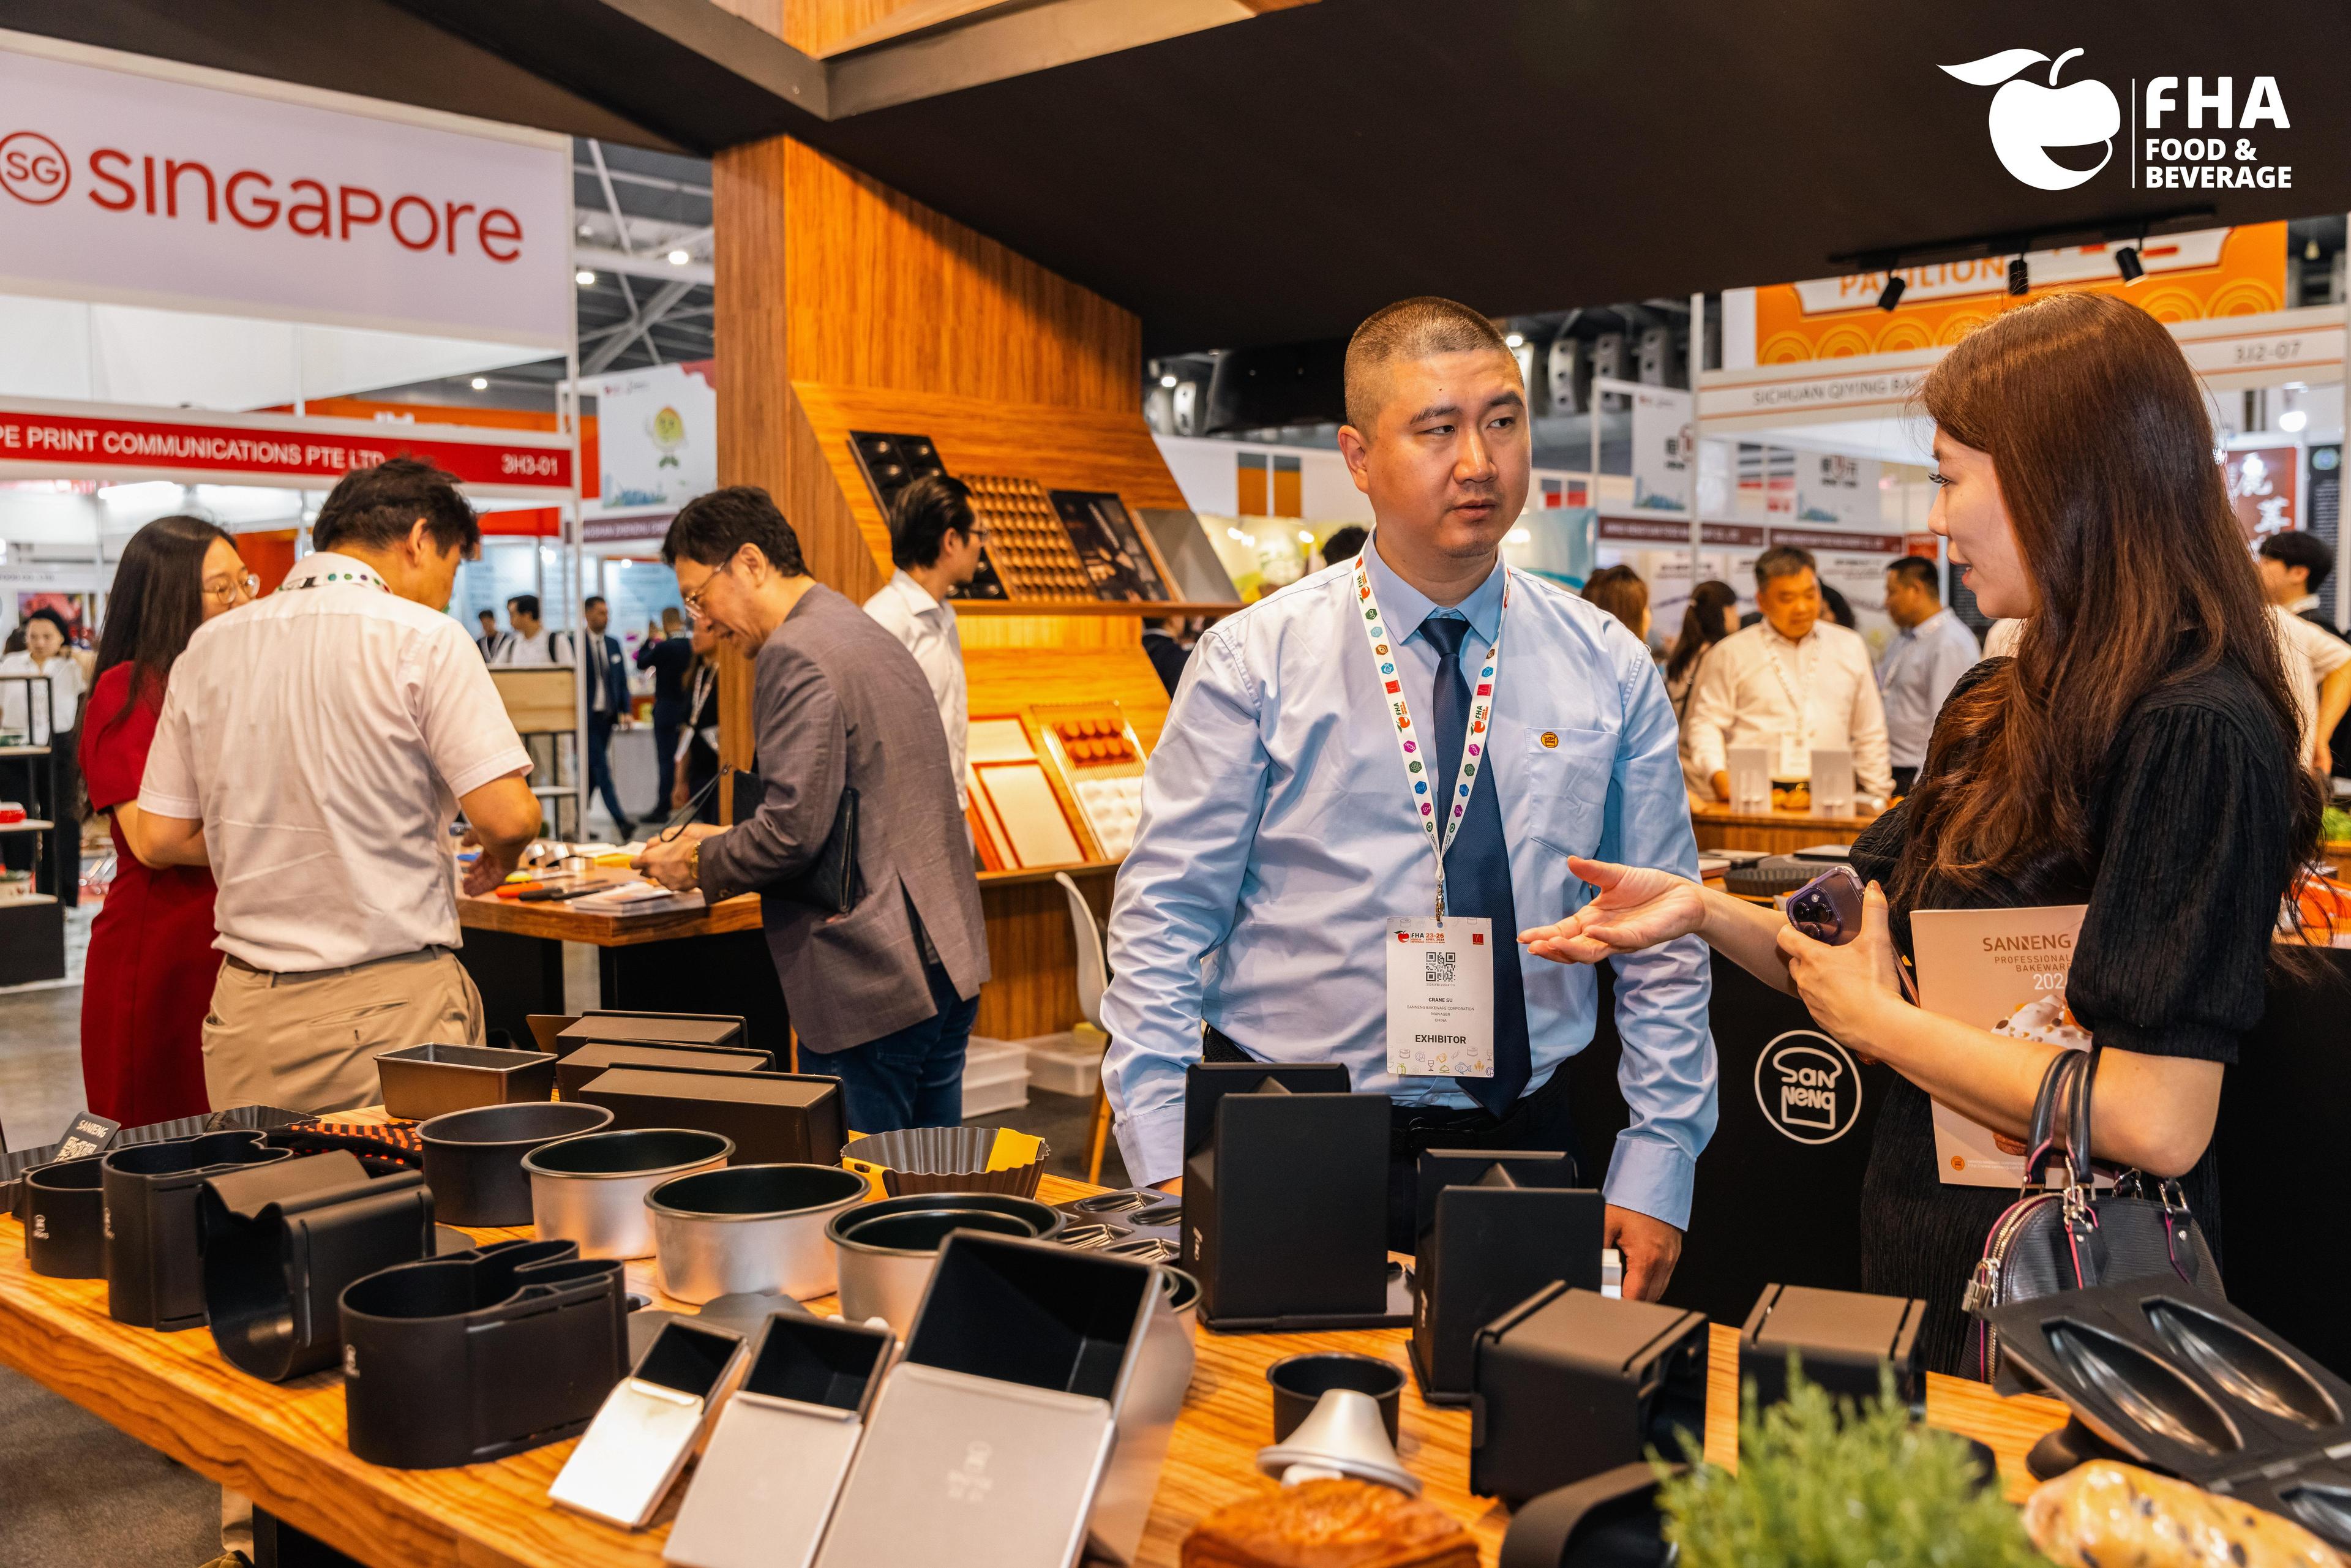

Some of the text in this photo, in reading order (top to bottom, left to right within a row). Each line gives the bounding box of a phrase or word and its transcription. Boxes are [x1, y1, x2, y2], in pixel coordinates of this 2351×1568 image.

[6, 151, 61, 185] SG
[1840, 256, 2005, 298] PAILION
[1752, 384, 1824, 405] SICHUAN
[27, 426, 99, 452] PRINT
[102, 430, 302, 466] COMMUNICATIONS
[305, 445, 346, 469] PTE
[501, 453, 558, 476] 3H3-01
[1393, 702, 1402, 715] FHA
[1994, 954, 2072, 964] PROFESSIONAL
[2033, 972, 2067, 990] 202
[1415, 1034, 1466, 1044] EXHIBITOR
